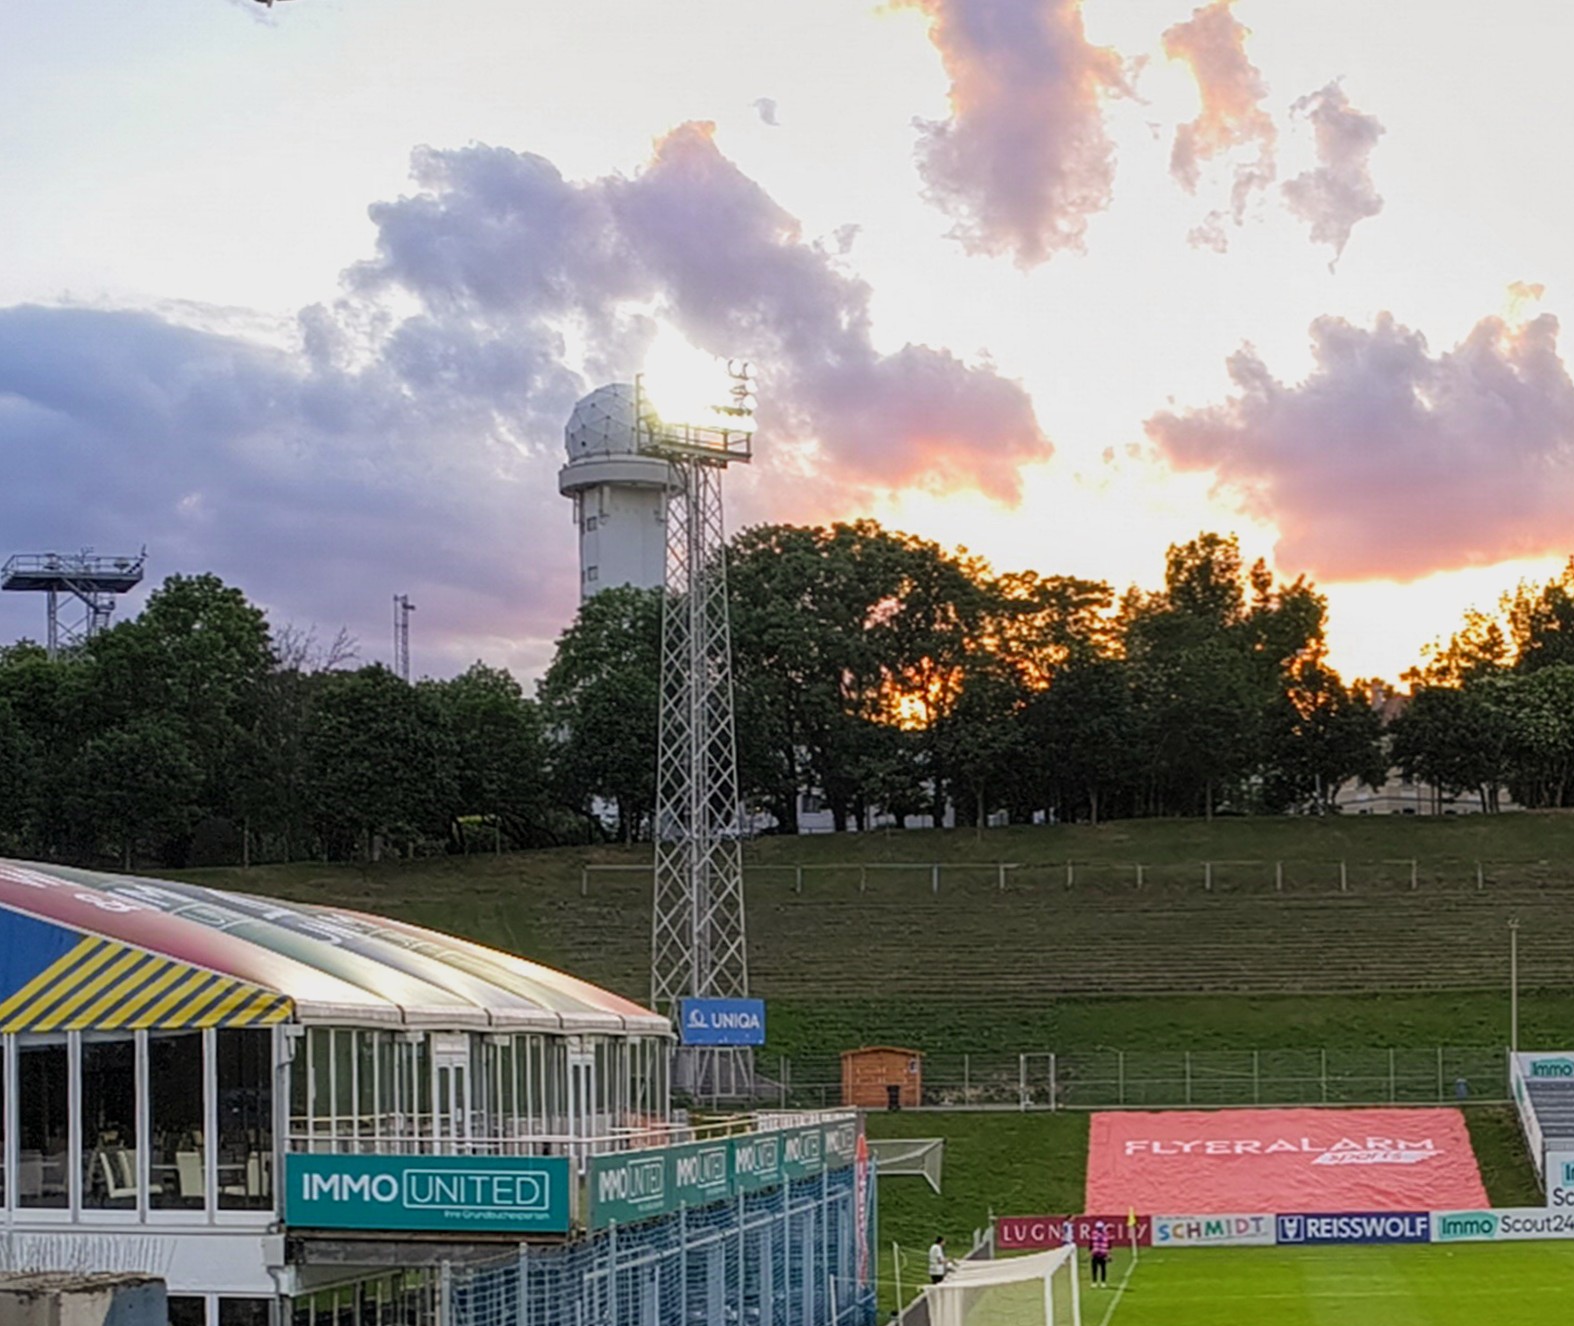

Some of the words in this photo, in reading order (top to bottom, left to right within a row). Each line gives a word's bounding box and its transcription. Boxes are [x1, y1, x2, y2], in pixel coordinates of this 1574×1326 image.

[711, 1013, 760, 1029] UNIQA
[1531, 1060, 1573, 1077] Immo
[1125, 1137, 1434, 1156] FLYERALARM
[303, 1173, 399, 1202] IMMO
[410, 1175, 541, 1205] UNITED
[1158, 1217, 1264, 1241] SCHMIDT
[1306, 1217, 1428, 1239] REISSWOLF
[1442, 1216, 1493, 1236] Immo
